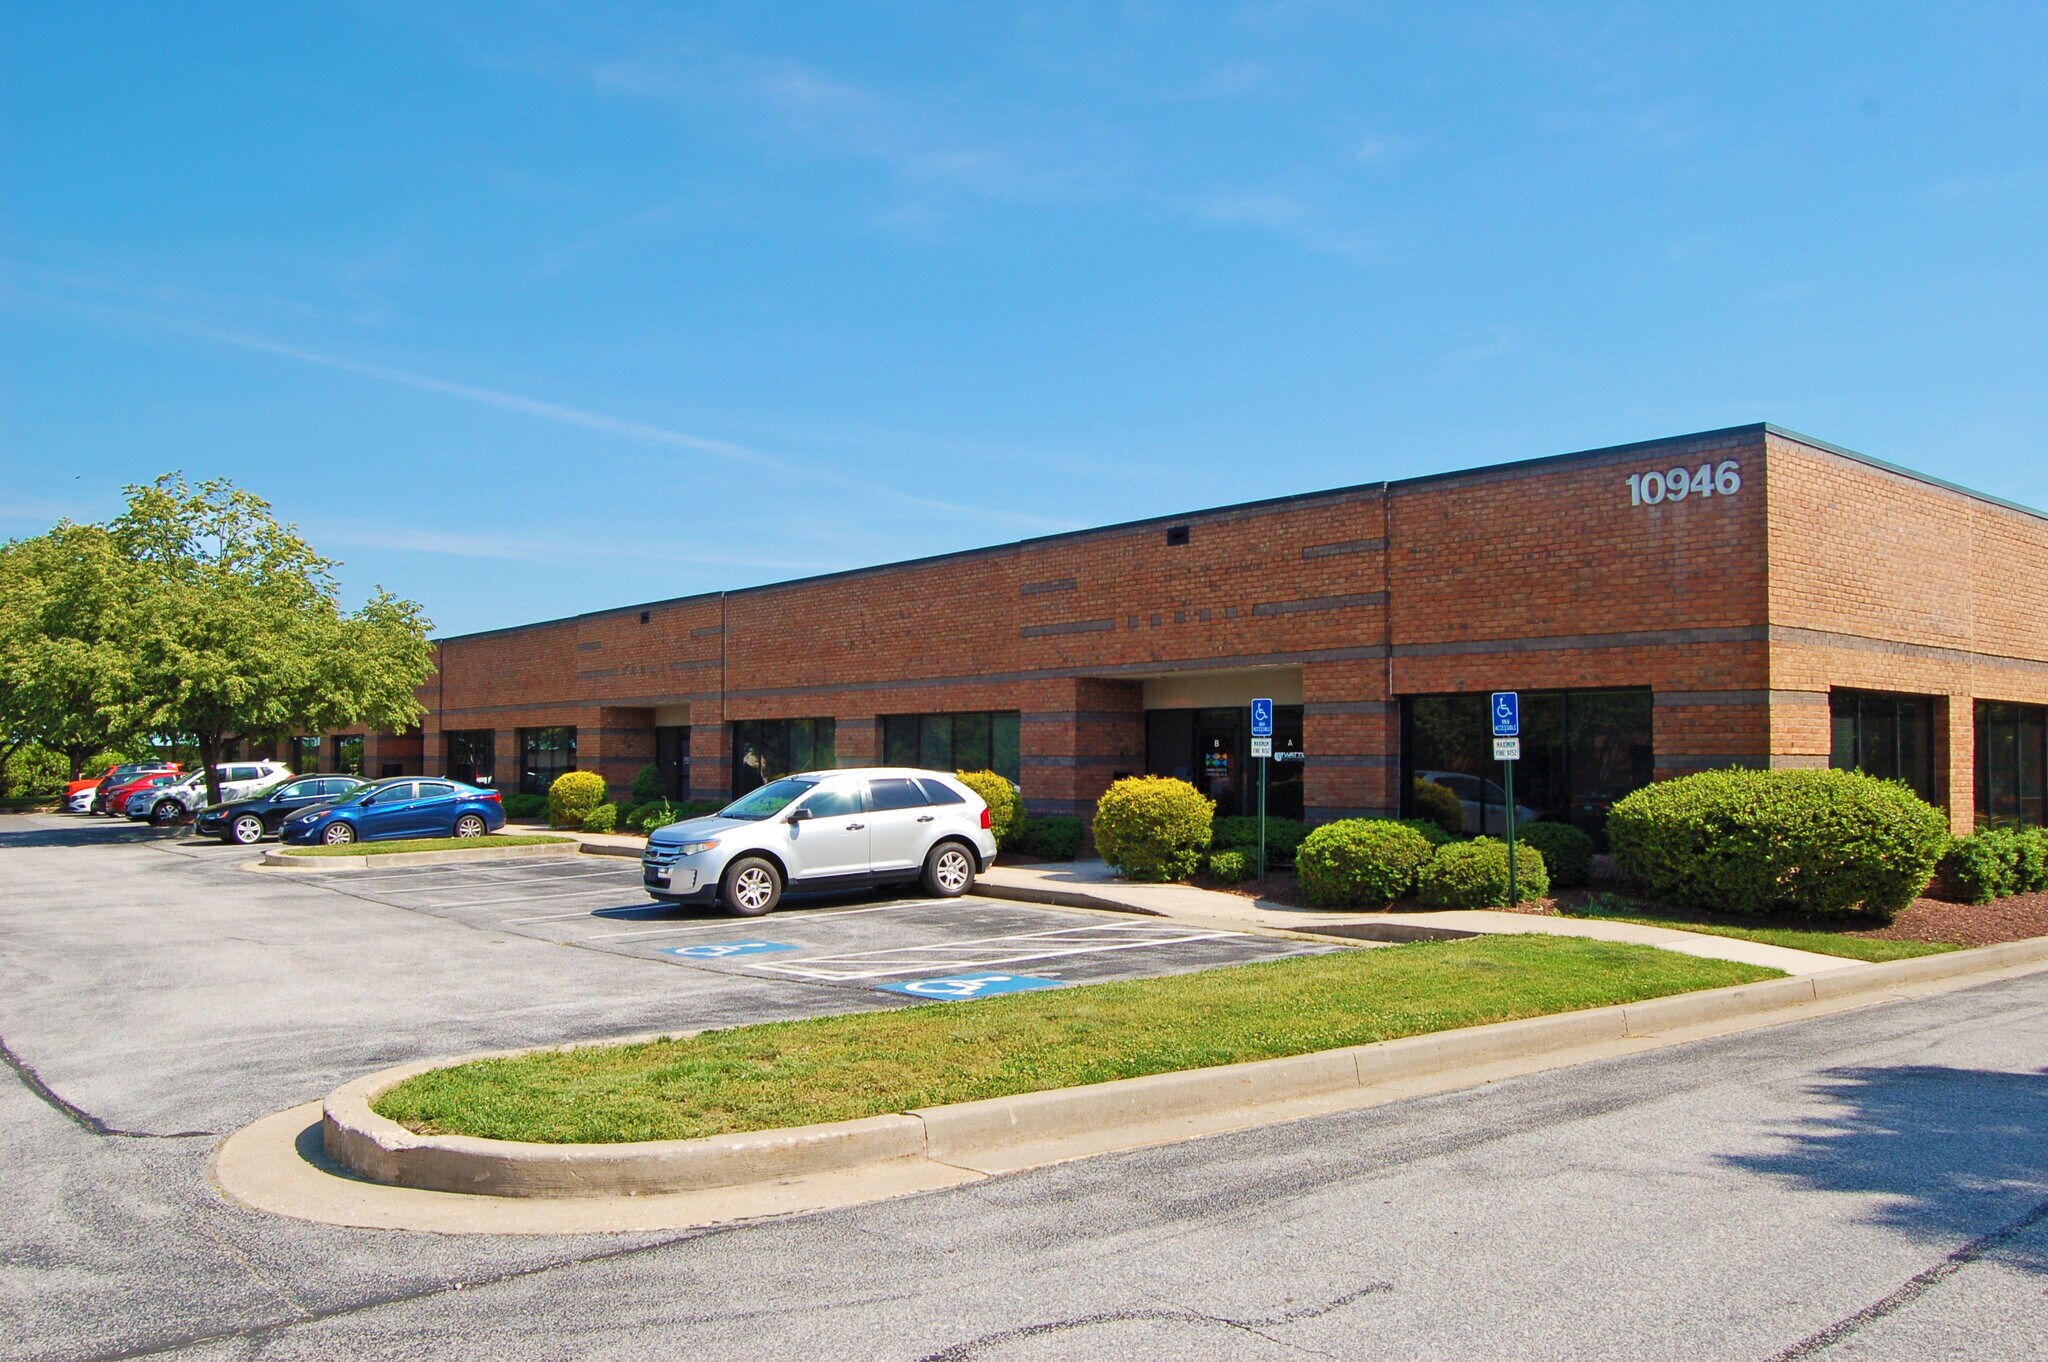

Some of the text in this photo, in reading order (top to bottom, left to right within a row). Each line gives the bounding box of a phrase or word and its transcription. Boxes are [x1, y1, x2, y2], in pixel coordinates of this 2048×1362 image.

[1625, 460, 1741, 506] 10946
[1214, 739, 1220, 748] B
[1287, 739, 1293, 747] A
